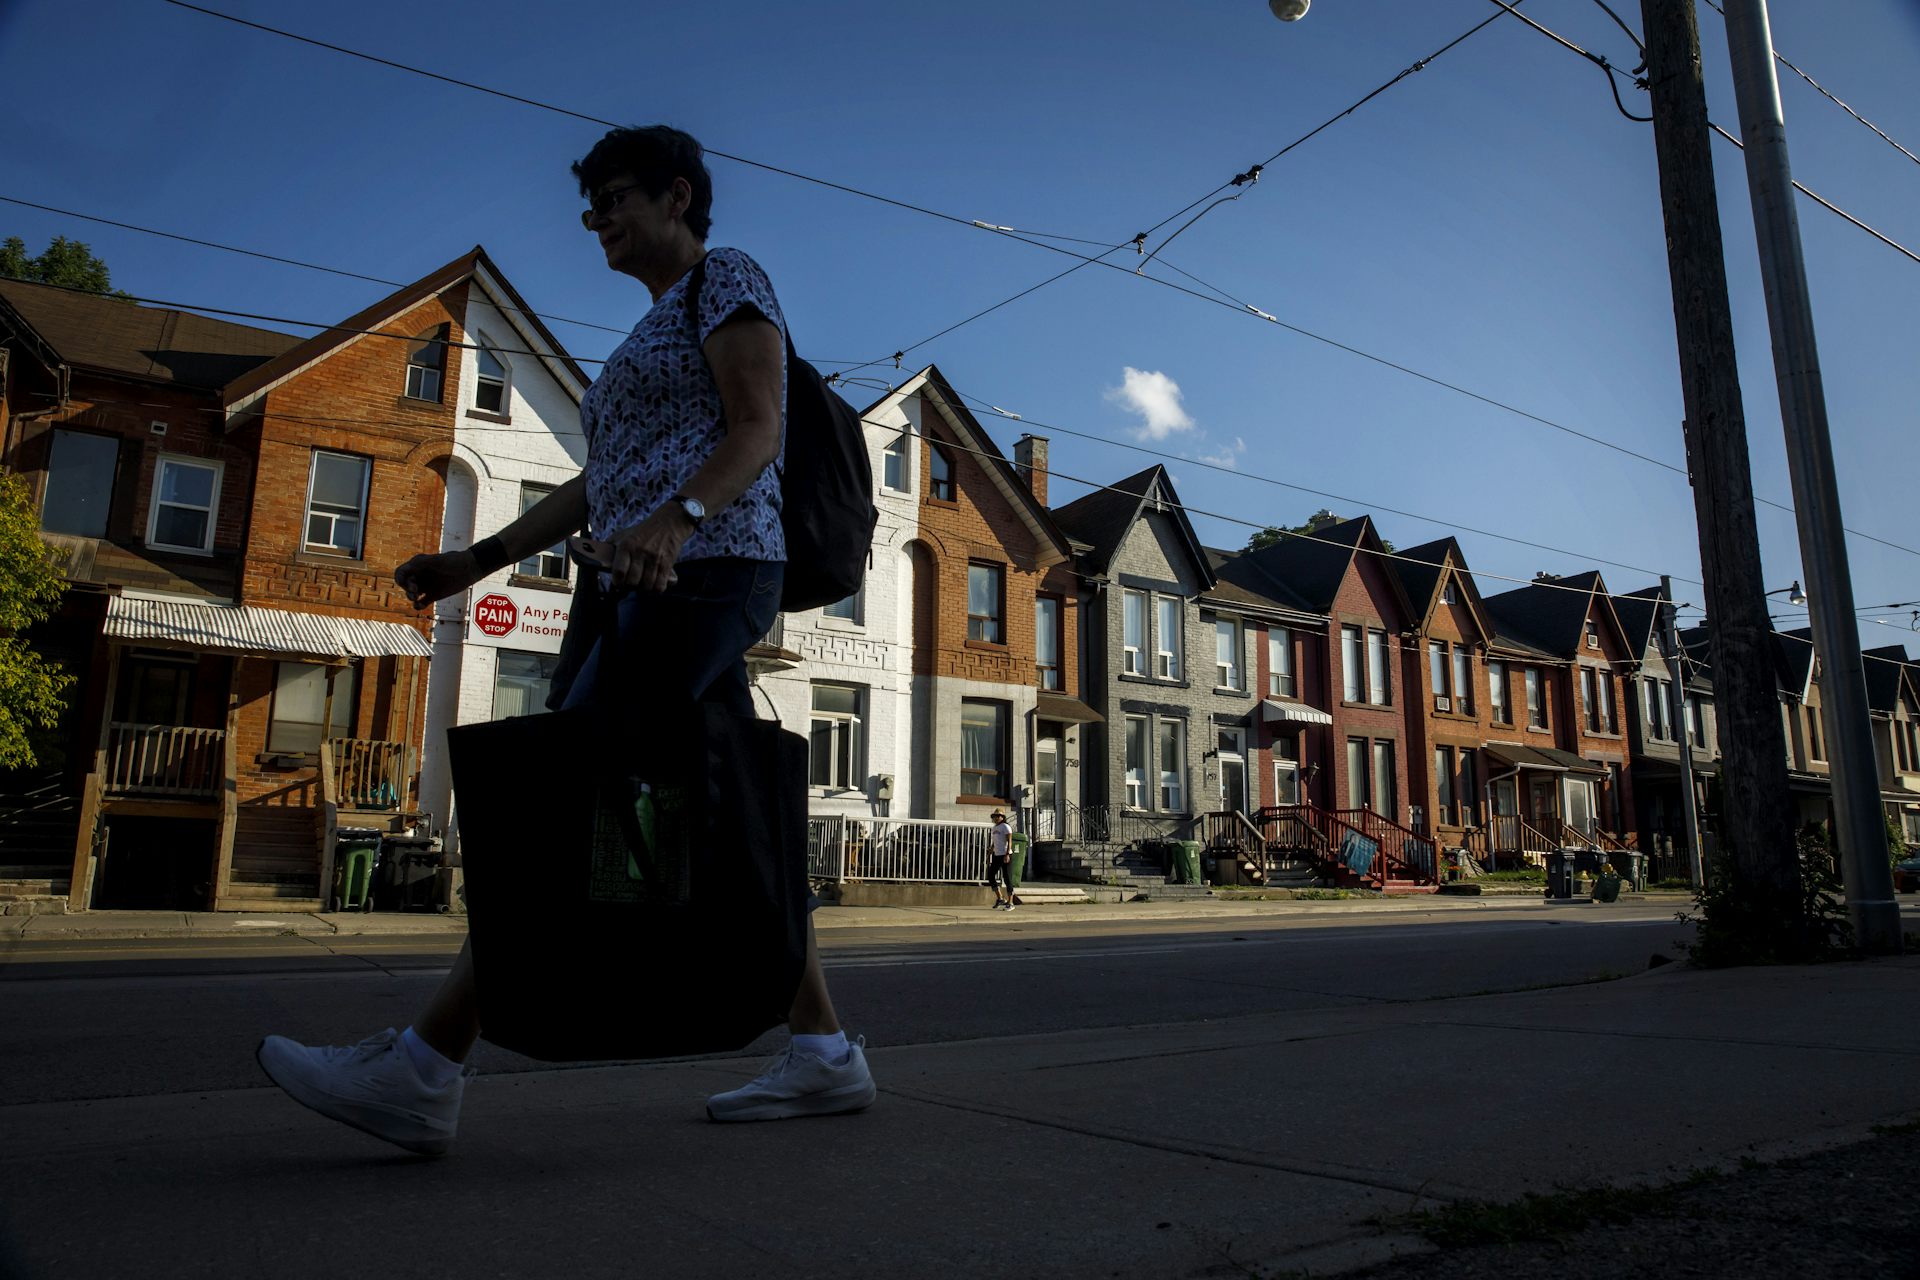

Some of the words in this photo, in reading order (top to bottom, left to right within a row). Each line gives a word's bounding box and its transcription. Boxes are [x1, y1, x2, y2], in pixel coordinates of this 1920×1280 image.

[487, 598, 508, 606] STOP
[478, 607, 513, 624] PAIN
[523, 605, 549, 620] Any
[484, 624, 506, 633] STOP
